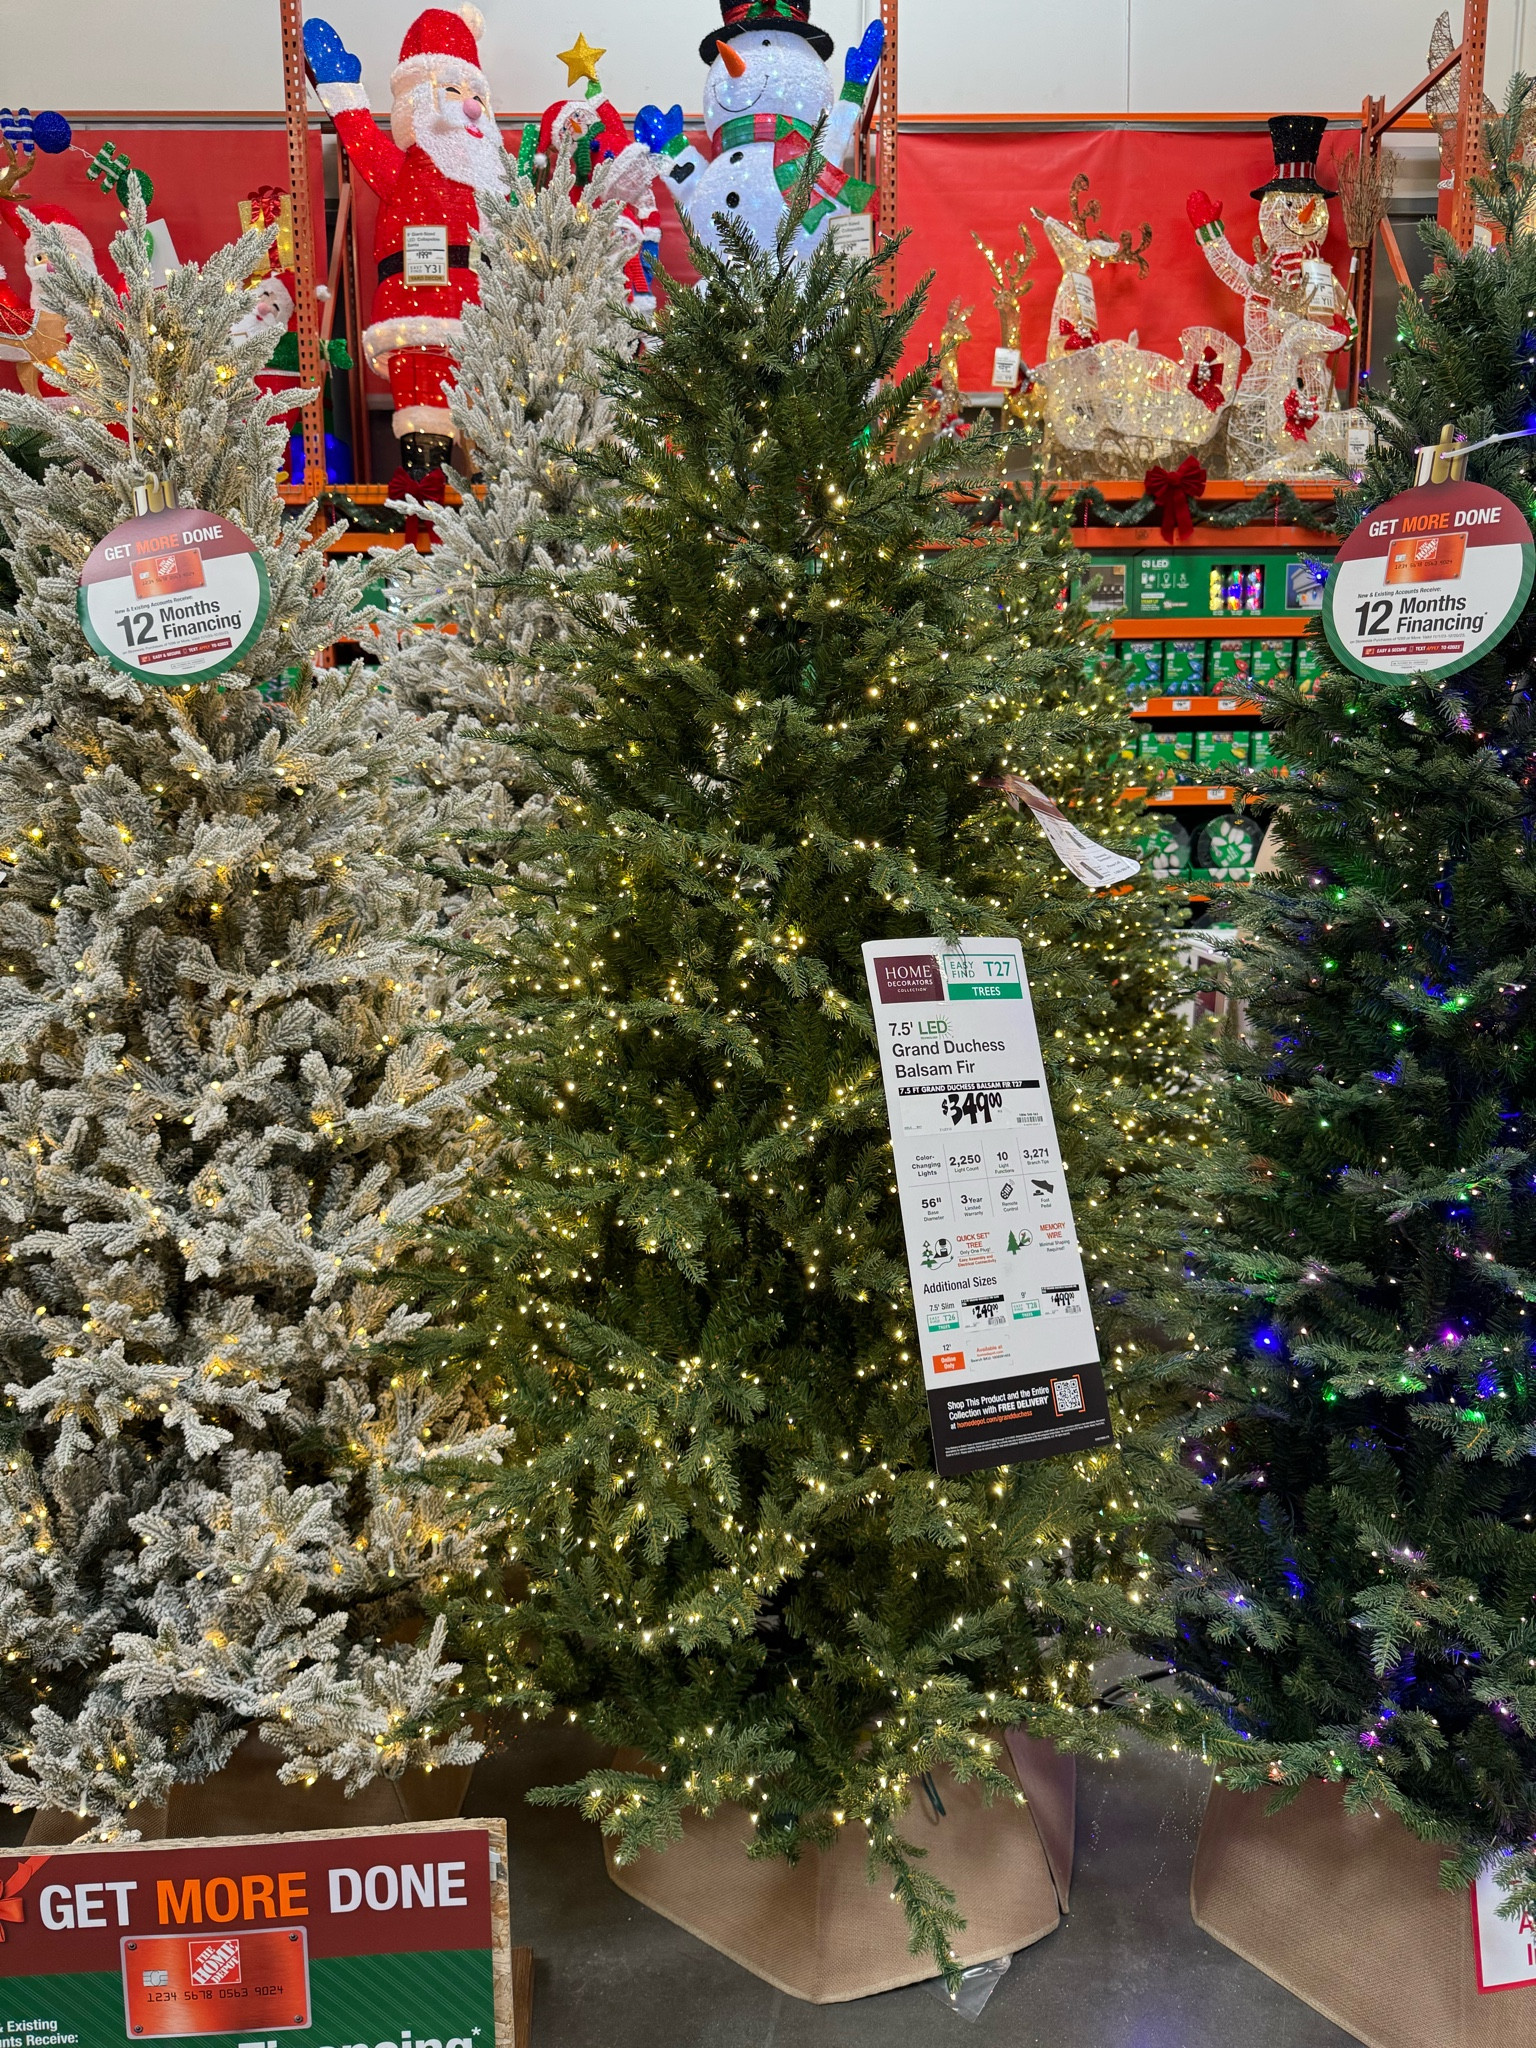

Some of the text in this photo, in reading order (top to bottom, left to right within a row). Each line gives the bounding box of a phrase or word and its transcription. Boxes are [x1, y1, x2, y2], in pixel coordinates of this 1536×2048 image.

[424, 264, 441, 273] Y31
[1369, 506, 1502, 538] GET MORE DONE
[104, 525, 224, 561] GET MORE DONE
[1415, 538, 1438, 560] HOME
[1151, 559, 1169, 568] LED
[1374, 589, 1394, 598] Existing
[1395, 587, 1419, 595] Accounts
[131, 604, 150, 612] Existing
[150, 599, 172, 607] Accounts
[117, 612, 158, 647] 12
[160, 600, 220, 623] Months
[1355, 595, 1467, 637] 12 Months
[885, 961, 1010, 980] HOME EASY T27
[887, 970, 975, 987] DECORATORS FIND
[972, 986, 1001, 996] TREES
[889, 1020, 948, 1037] 7.5' LED
[892, 1039, 1005, 1057] Grand Duchess
[895, 1060, 976, 1078] Balsam Fir
[900, 1087, 911, 1095] 7.5
[921, 1085, 945, 1093] GRAND
[947, 1083, 975, 1092] DUCHESS
[976, 1081, 1001, 1089] BALSAM
[1012, 1080, 1022, 1088] T27
[949, 1154, 981, 1167] 2,250
[996, 1151, 1008, 1161] 10
[1023, 1148, 1049, 1160] 3,271
[911, 1162, 941, 1170] Changing
[960, 1195, 983, 1204] 3 Year
[1040, 1222, 1065, 1231] MEMORY
[956, 1233, 976, 1242] QUICK
[1046, 1231, 1063, 1239] WIRE
[966, 1241, 983, 1249] TREE
[923, 1276, 997, 1294] Additional Sizes
[941, 1302, 955, 1310] Slim
[943, 1313, 956, 1321] T26
[947, 1386, 1049, 1411] Shop This Product and the Entire
[949, 1408, 982, 1421] Collection
[982, 1405, 997, 1415] with
[998, 1402, 1016, 1413] FREE
[957, 1411, 1033, 1429] homedepot.com/grandduchess
[39, 1861, 468, 1930] GET MORE DONE
[191, 1940, 239, 1985] HOME
[195, 1945, 216, 1964] THE
[211, 1956, 240, 1984] DEPOT
[147, 1985, 284, 2002] 1234 5678 0563 9024
[7, 2019, 58, 2032] Existing
[26, 2033, 79, 2046] Receive:
